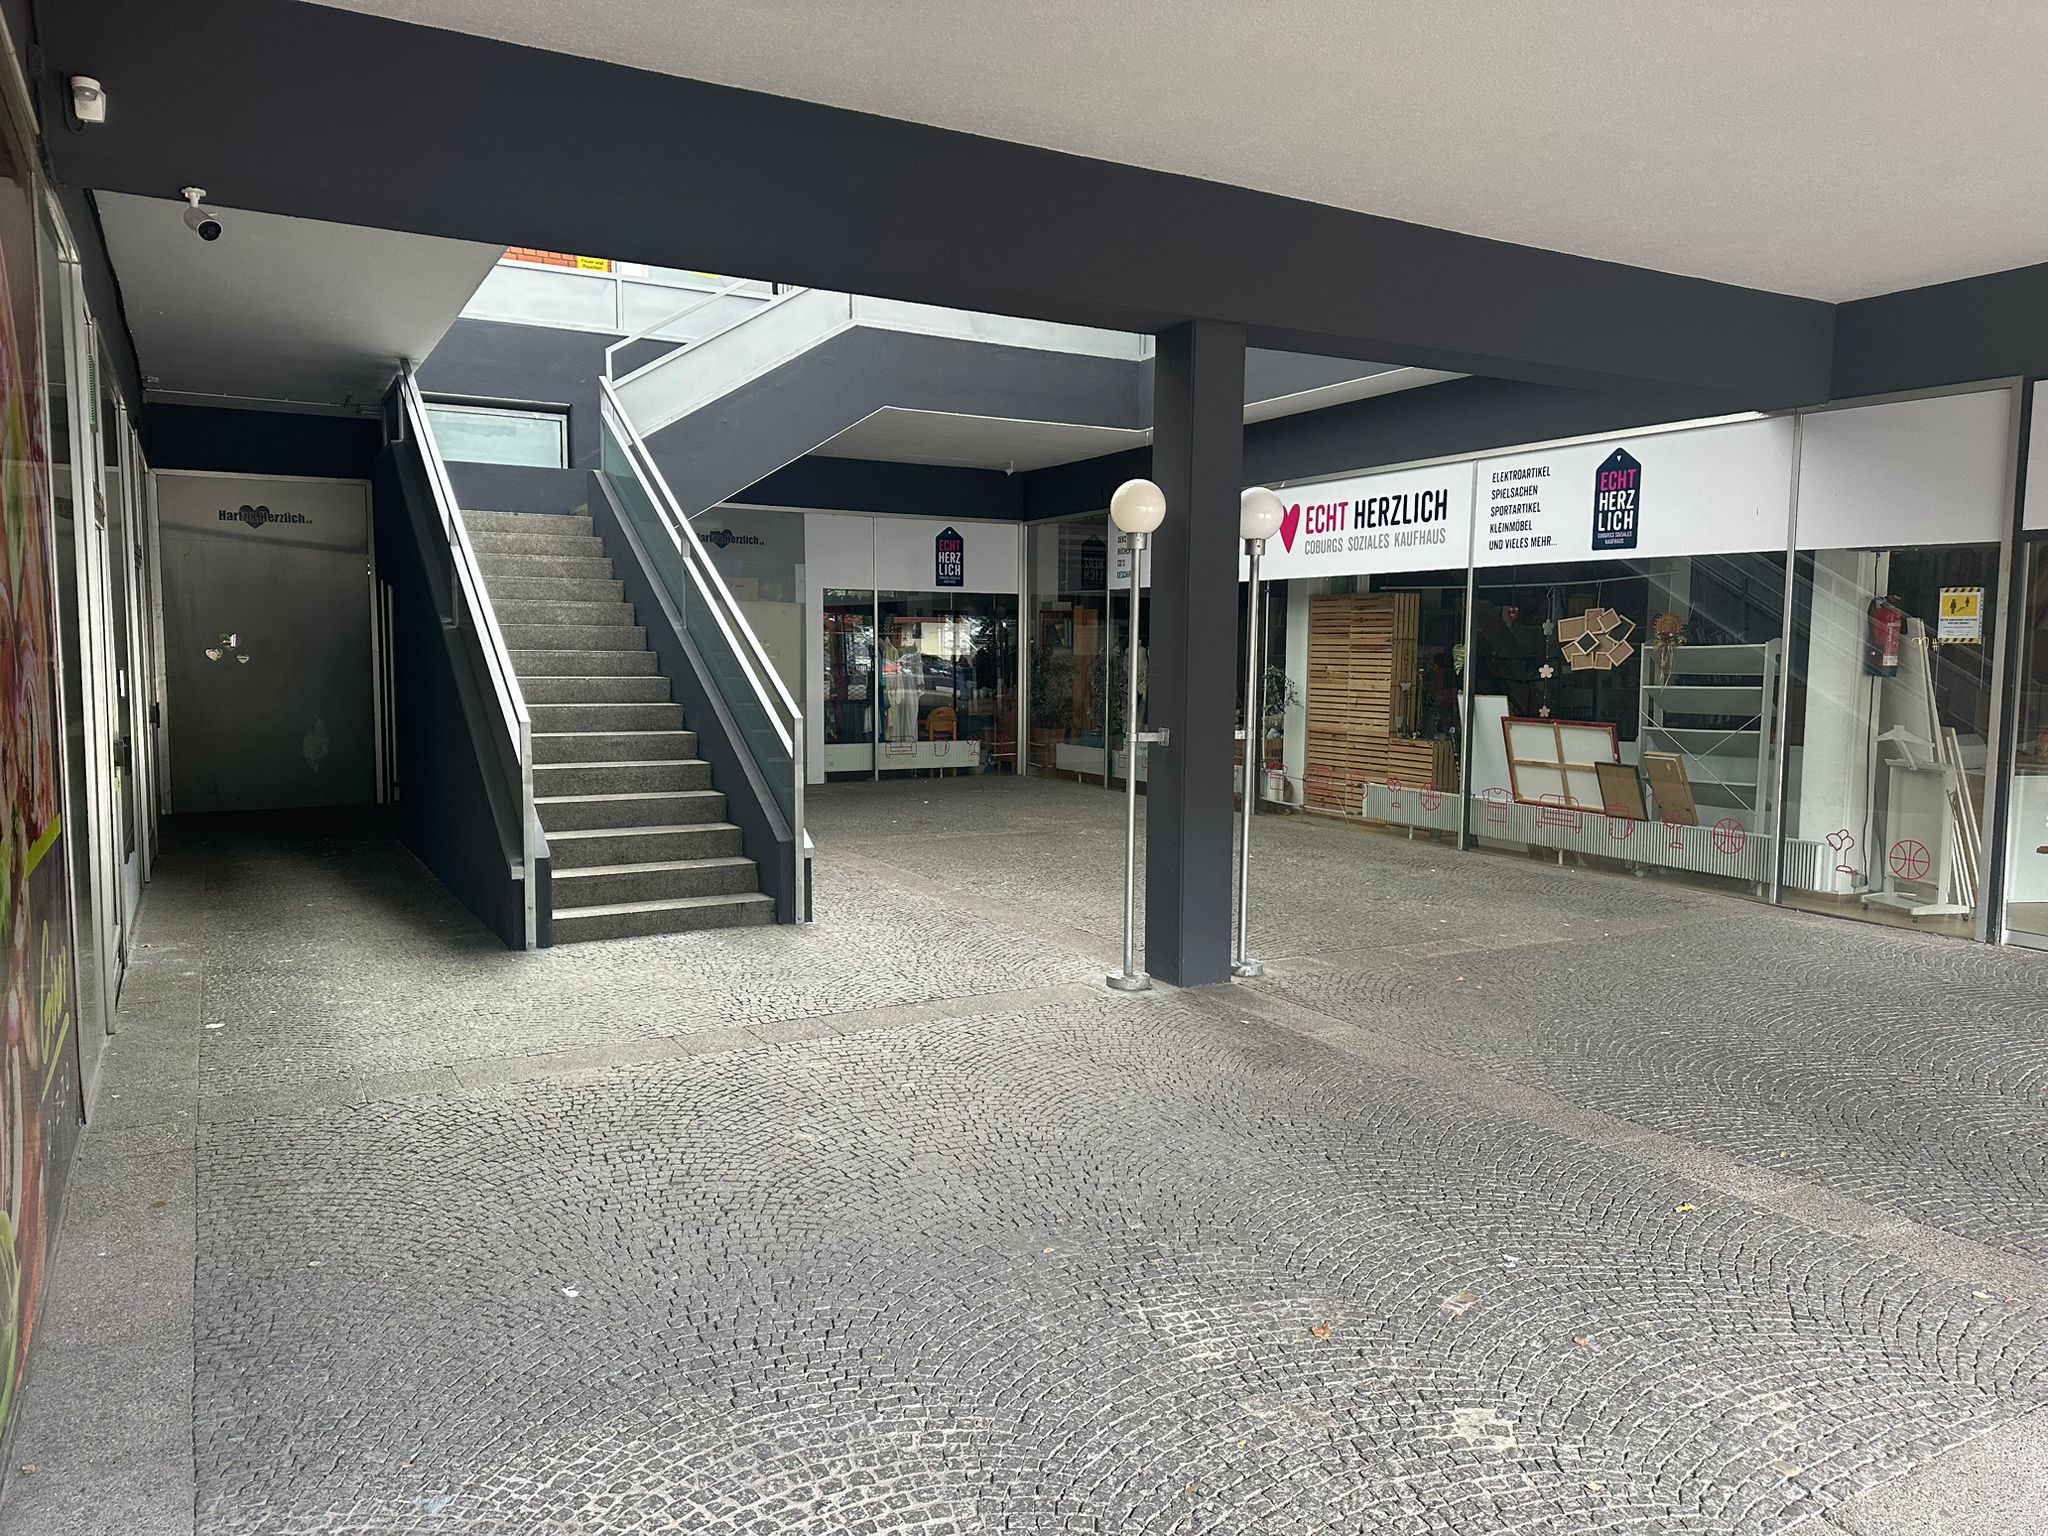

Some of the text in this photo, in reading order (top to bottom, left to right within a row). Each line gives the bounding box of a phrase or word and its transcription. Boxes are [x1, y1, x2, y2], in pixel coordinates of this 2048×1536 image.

[1491, 466, 1551, 483] ELEKTROARTIKEL
[1600, 468, 1637, 491] ECHT
[1491, 485, 1539, 500] SPIELSACHEN
[1599, 489, 1636, 511] HERZ
[1305, 488, 1448, 535] ECHT HERZLICH
[1490, 502, 1541, 517] SPORTARTIKEL
[1489, 519, 1533, 534] KLEINMÖBEL
[1597, 510, 1634, 531] LICH
[939, 540, 961, 551] ECHT
[1304, 527, 1446, 555] COBURGS SOZIALES KAUFHAUS
[1488, 539, 1504, 551] UND
[1504, 537, 1529, 550] VIELES
[938, 552, 961, 564] HERZ
[938, 564, 961, 576] LICH
